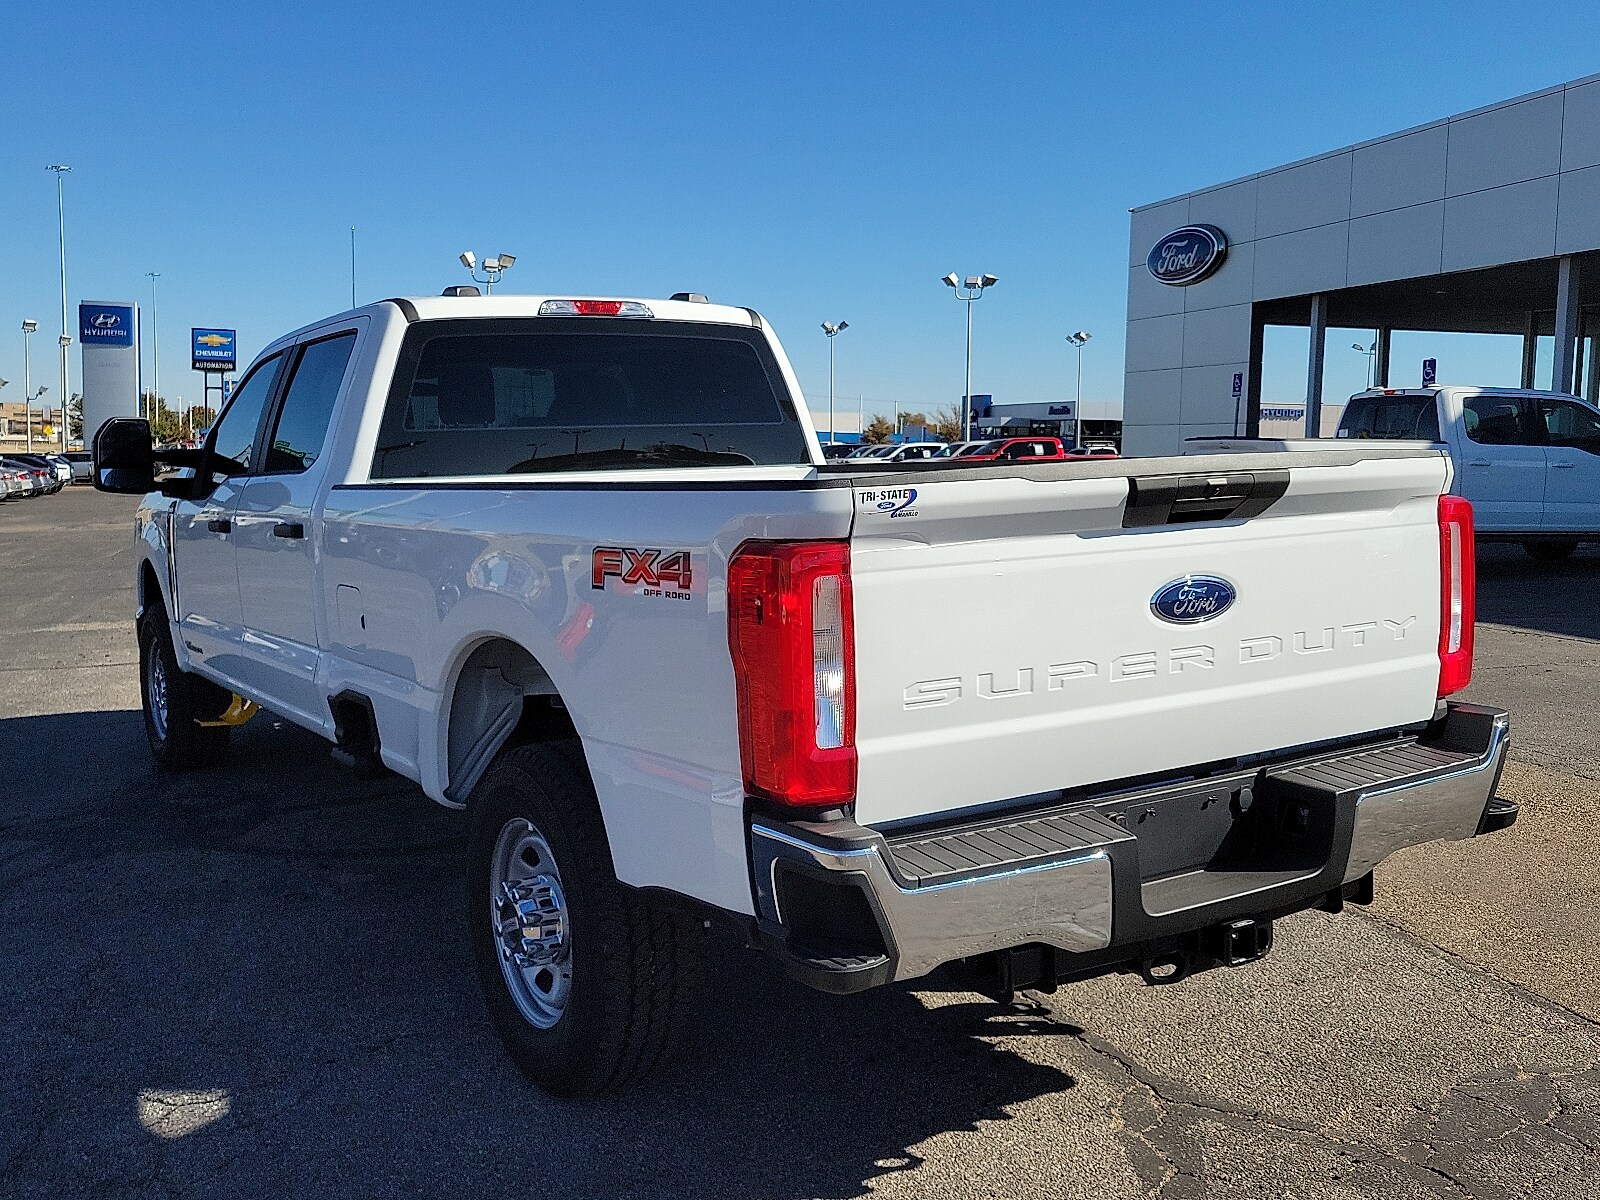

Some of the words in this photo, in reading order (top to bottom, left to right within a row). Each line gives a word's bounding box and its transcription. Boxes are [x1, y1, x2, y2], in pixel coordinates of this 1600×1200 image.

[1158, 240, 1199, 273] Ford
[84, 328, 127, 337] HYUNDAI
[195, 350, 232, 358] CHEVROLET
[195, 361, 233, 369] AUTONATION
[859, 489, 909, 504] TRI-STATE
[592, 546, 692, 590] FX4
[643, 588, 662, 598] OFF
[665, 591, 691, 600] ROAD
[1173, 586, 1218, 615] Ford
[902, 644, 1215, 711] SUPER
[1239, 615, 1417, 664] DUTY
